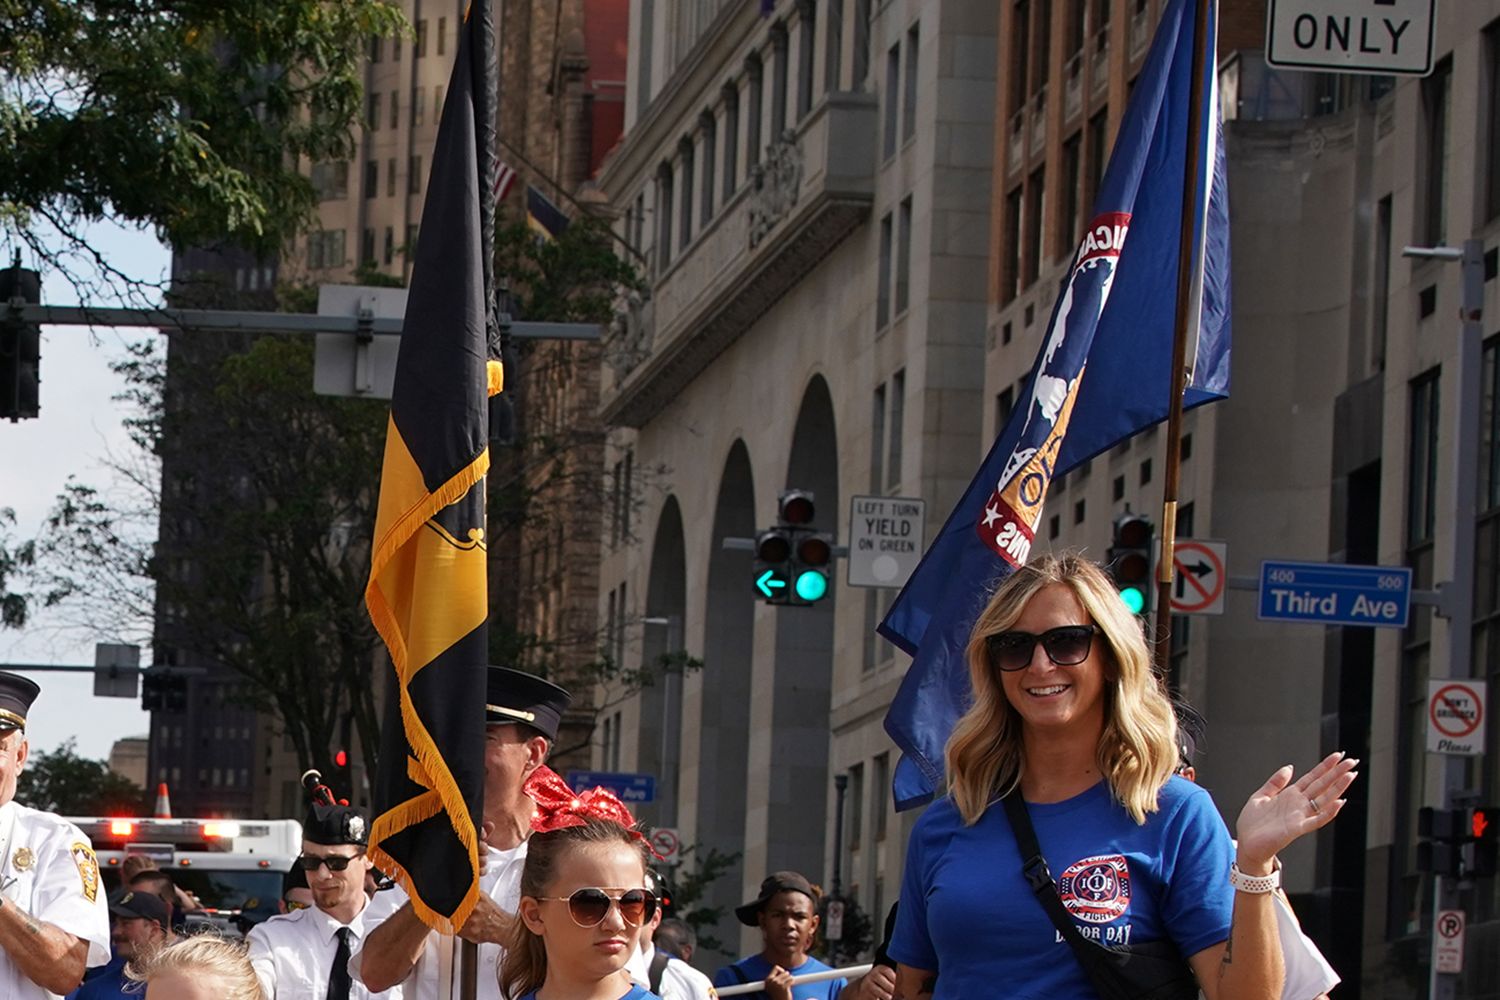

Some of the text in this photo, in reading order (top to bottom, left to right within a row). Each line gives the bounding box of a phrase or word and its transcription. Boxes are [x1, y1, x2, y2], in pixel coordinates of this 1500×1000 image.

[1293, 13, 1411, 55] ONLY
[858, 502, 919, 516] LEFT TURN
[866, 518, 911, 537] YIELD
[858, 538, 915, 552] ON GREEN
[1270, 569, 1402, 589] 400 500
[1271, 589, 1398, 619] Third Ave
[1437, 739, 1472, 752] Please
[1055, 924, 1131, 945] LOR DAY
